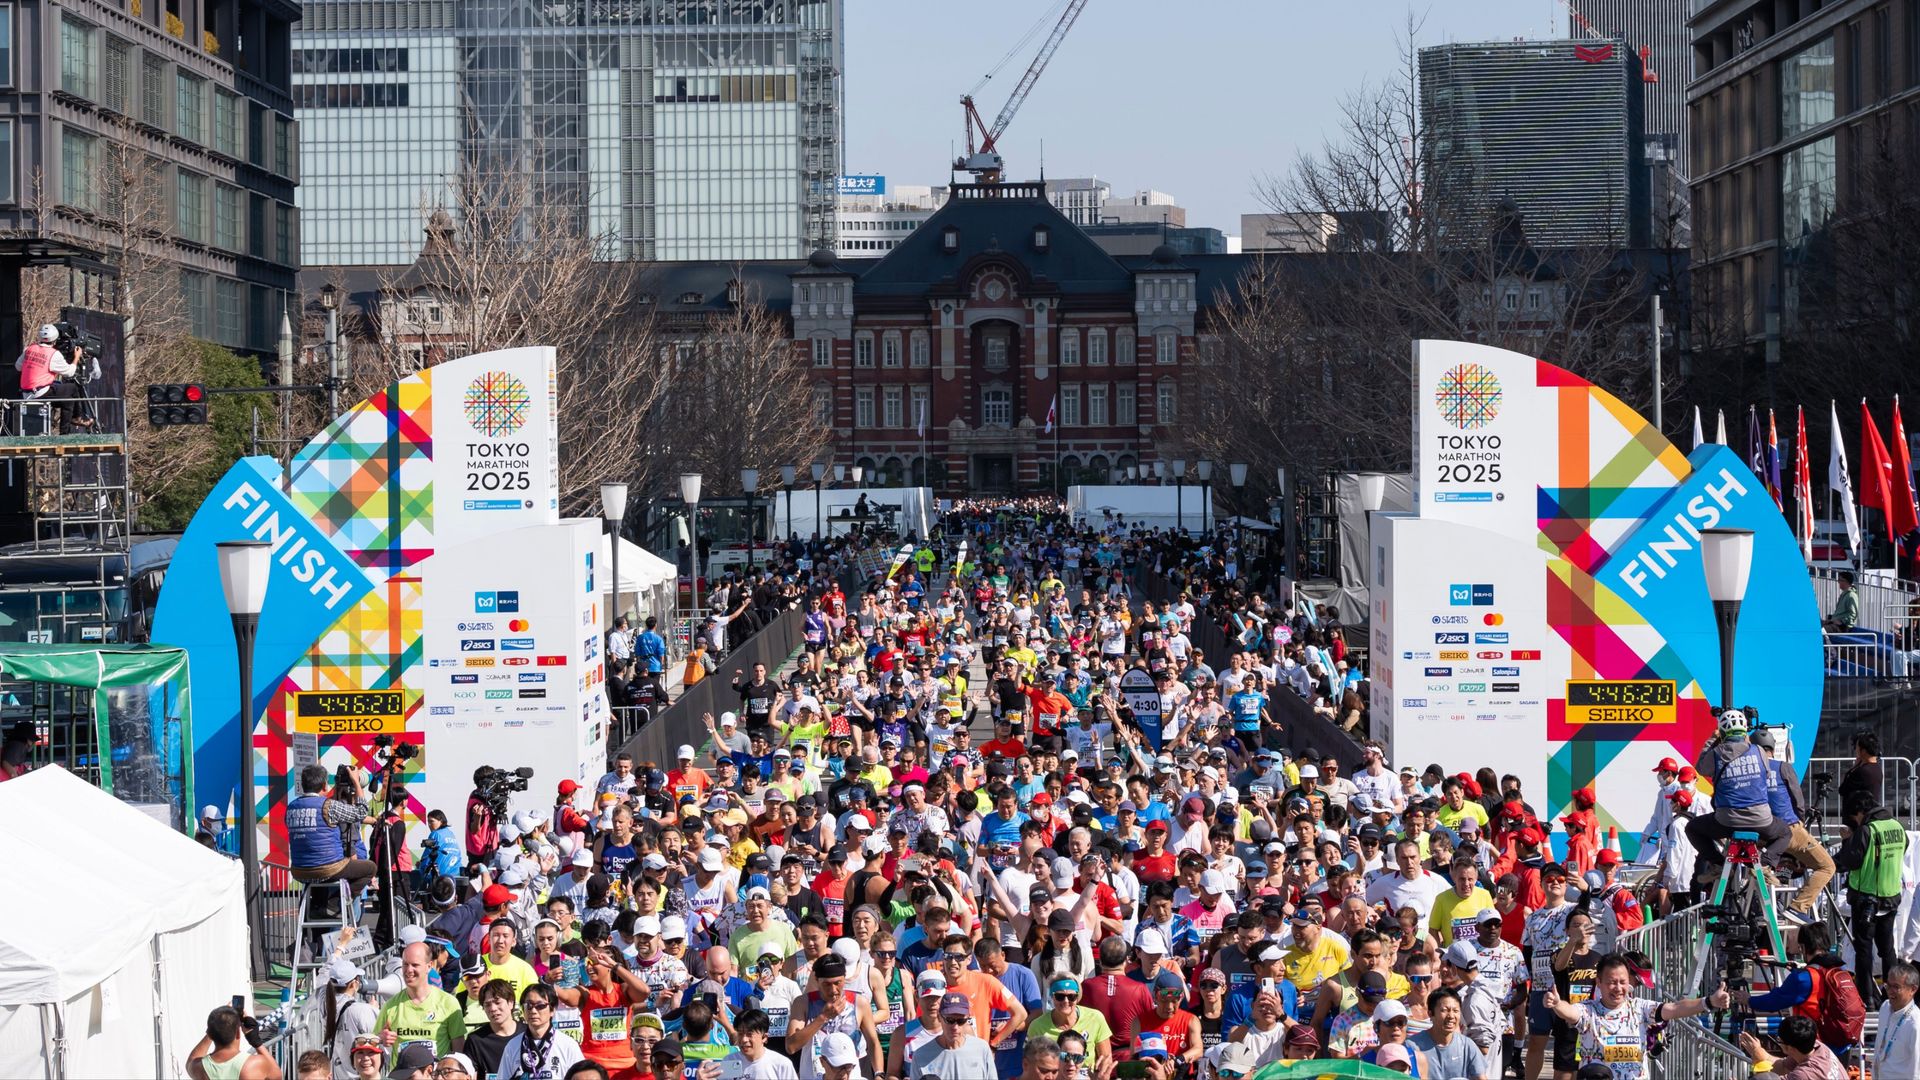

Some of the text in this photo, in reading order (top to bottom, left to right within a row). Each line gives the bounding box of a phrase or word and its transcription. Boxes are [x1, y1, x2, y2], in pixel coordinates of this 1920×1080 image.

[1437, 435, 1501, 450] TOKYO
[466, 443, 530, 458] TOKYO
[1438, 452, 1500, 461] MARATHON
[467, 460, 529, 469] MARATHON
[1438, 464, 1502, 482] 2025
[466, 472, 530, 490] 2025
[1618, 468, 1748, 598] FINISH
[222, 481, 353, 610] FINISH
[467, 622, 494, 631] STARTS
[1442, 616, 1469, 624] STARTS
[1588, 684, 1670, 702] 4:46:20
[318, 694, 400, 714] 4:46:20
[1134, 701, 1158, 711] 4:30
[1589, 708, 1653, 721] SEIKO
[319, 718, 384, 732] SEIKO
[1718, 754, 1758, 769] SONSOR
[1720, 764, 1760, 778] CAMERA
[1568, 969, 1597, 981] TAIPE
[397, 1028, 431, 1036] Edwin
